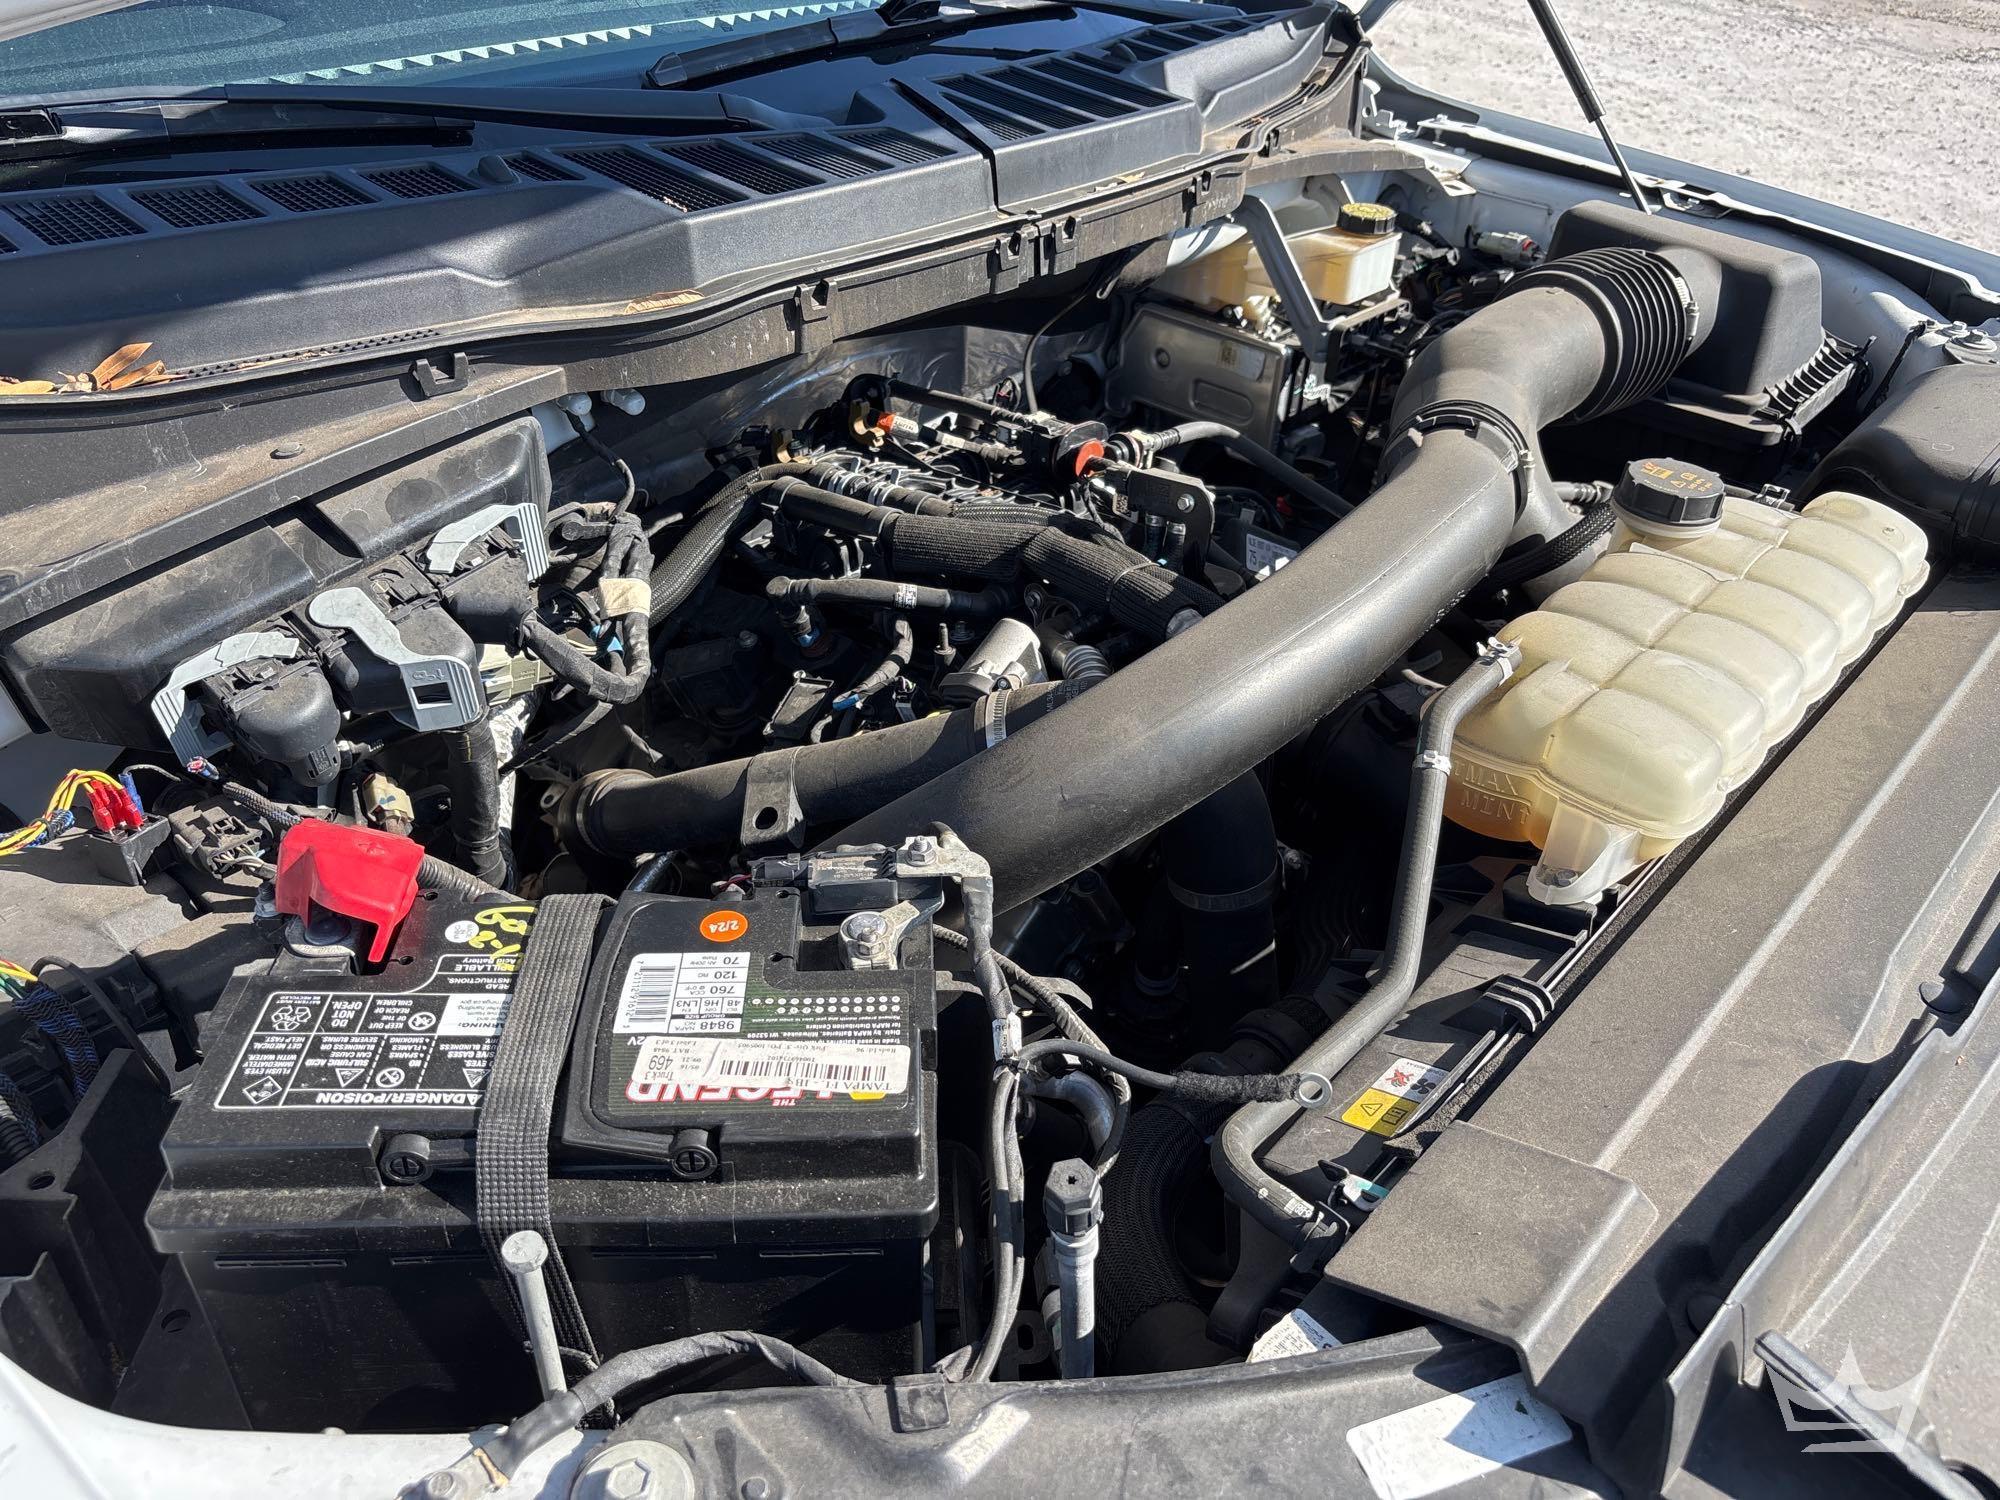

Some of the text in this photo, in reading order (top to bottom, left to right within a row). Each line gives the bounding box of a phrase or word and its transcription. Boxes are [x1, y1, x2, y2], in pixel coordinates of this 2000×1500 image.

[1462, 790, 1516, 821] MIN
[708, 920, 739, 934] 2/24
[723, 956, 740, 965] 70
[714, 971, 738, 979] 120
[710, 986, 736, 994] 760
[332, 1001, 362, 1010] OPEN.
[331, 1010, 355, 1018] NOT
[331, 1019, 349, 1027] DO
[700, 1021, 734, 1030] 9848
[627, 1036, 646, 1046] 2V
[327, 1059, 370, 1067] SULFURIC
[648, 1055, 674, 1070] 469
[315, 1092, 467, 1104] DANGER/POISON
